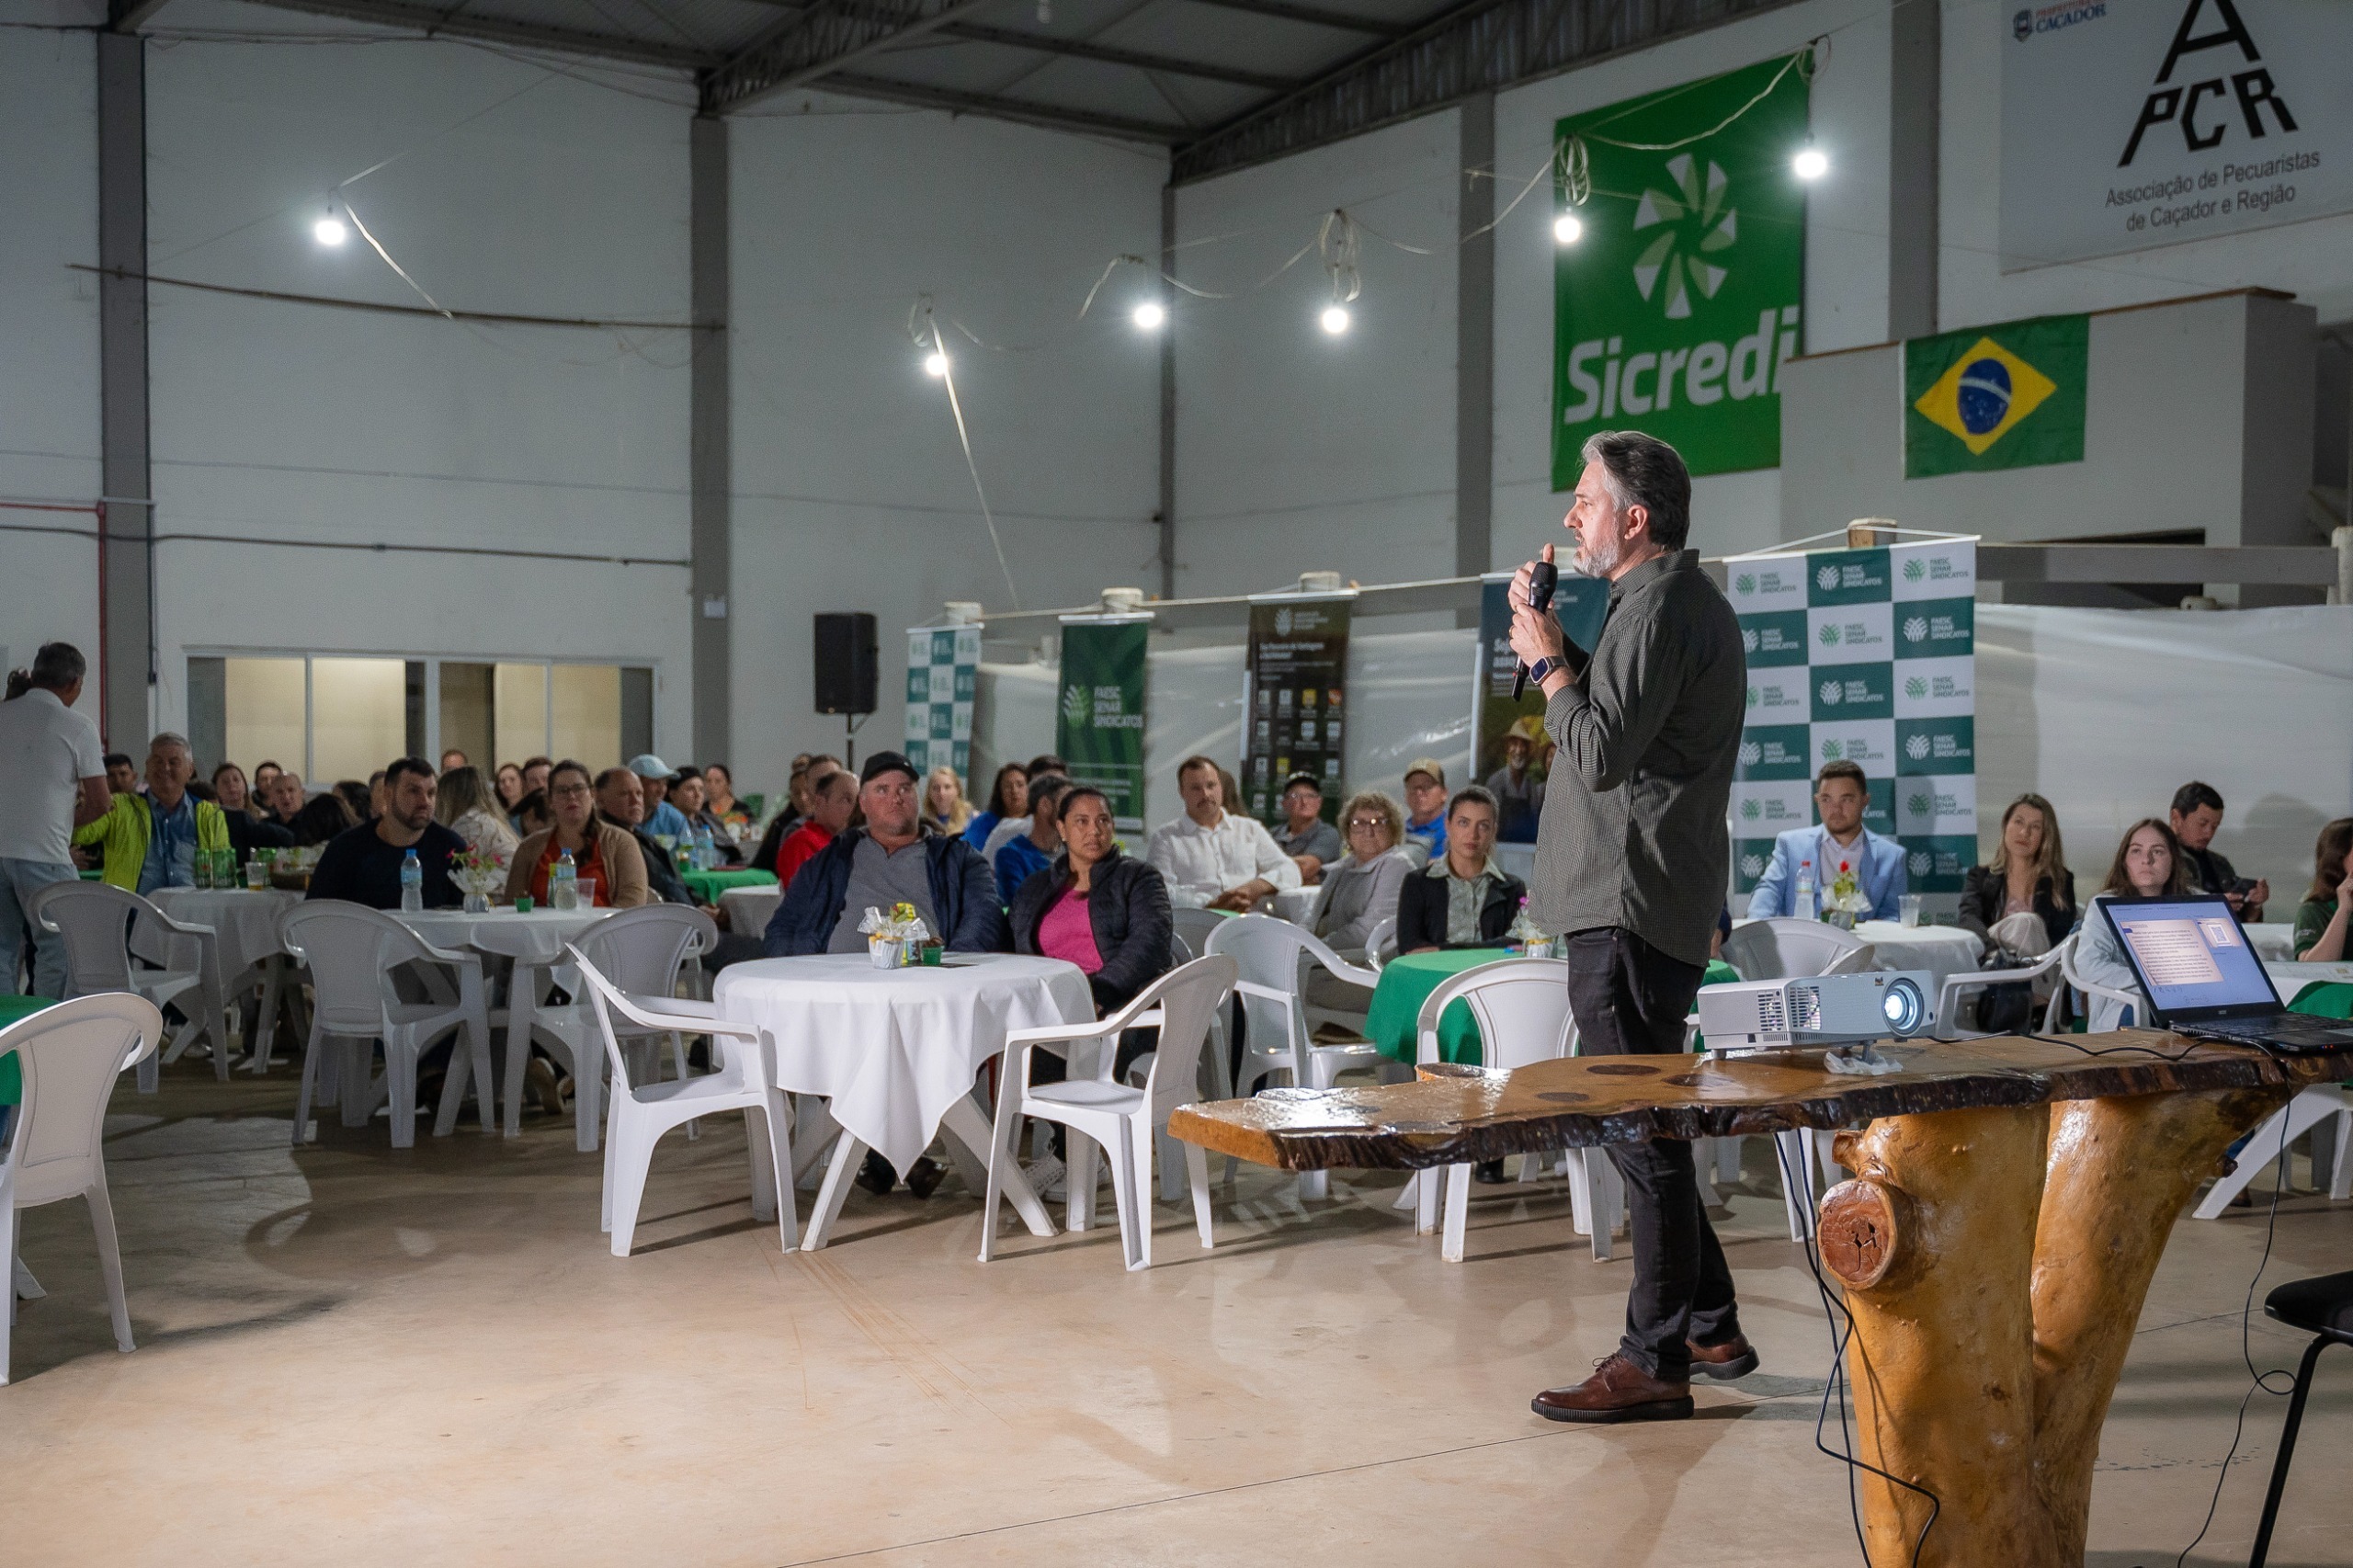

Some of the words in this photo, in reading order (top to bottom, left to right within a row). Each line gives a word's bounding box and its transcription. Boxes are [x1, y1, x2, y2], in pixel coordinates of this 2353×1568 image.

[2154, 0, 2261, 86] A
[2117, 67, 2299, 168] PCR
[2105, 175, 2193, 208] Associação
[2198, 169, 2218, 189] de
[2222, 150, 2321, 186] Pecuaristas
[2126, 212, 2145, 232] de
[2150, 199, 2217, 228] Caçador
[2221, 198, 2232, 214] e
[2237, 185, 2296, 213] Região
[1563, 304, 1800, 425] Sicredi
